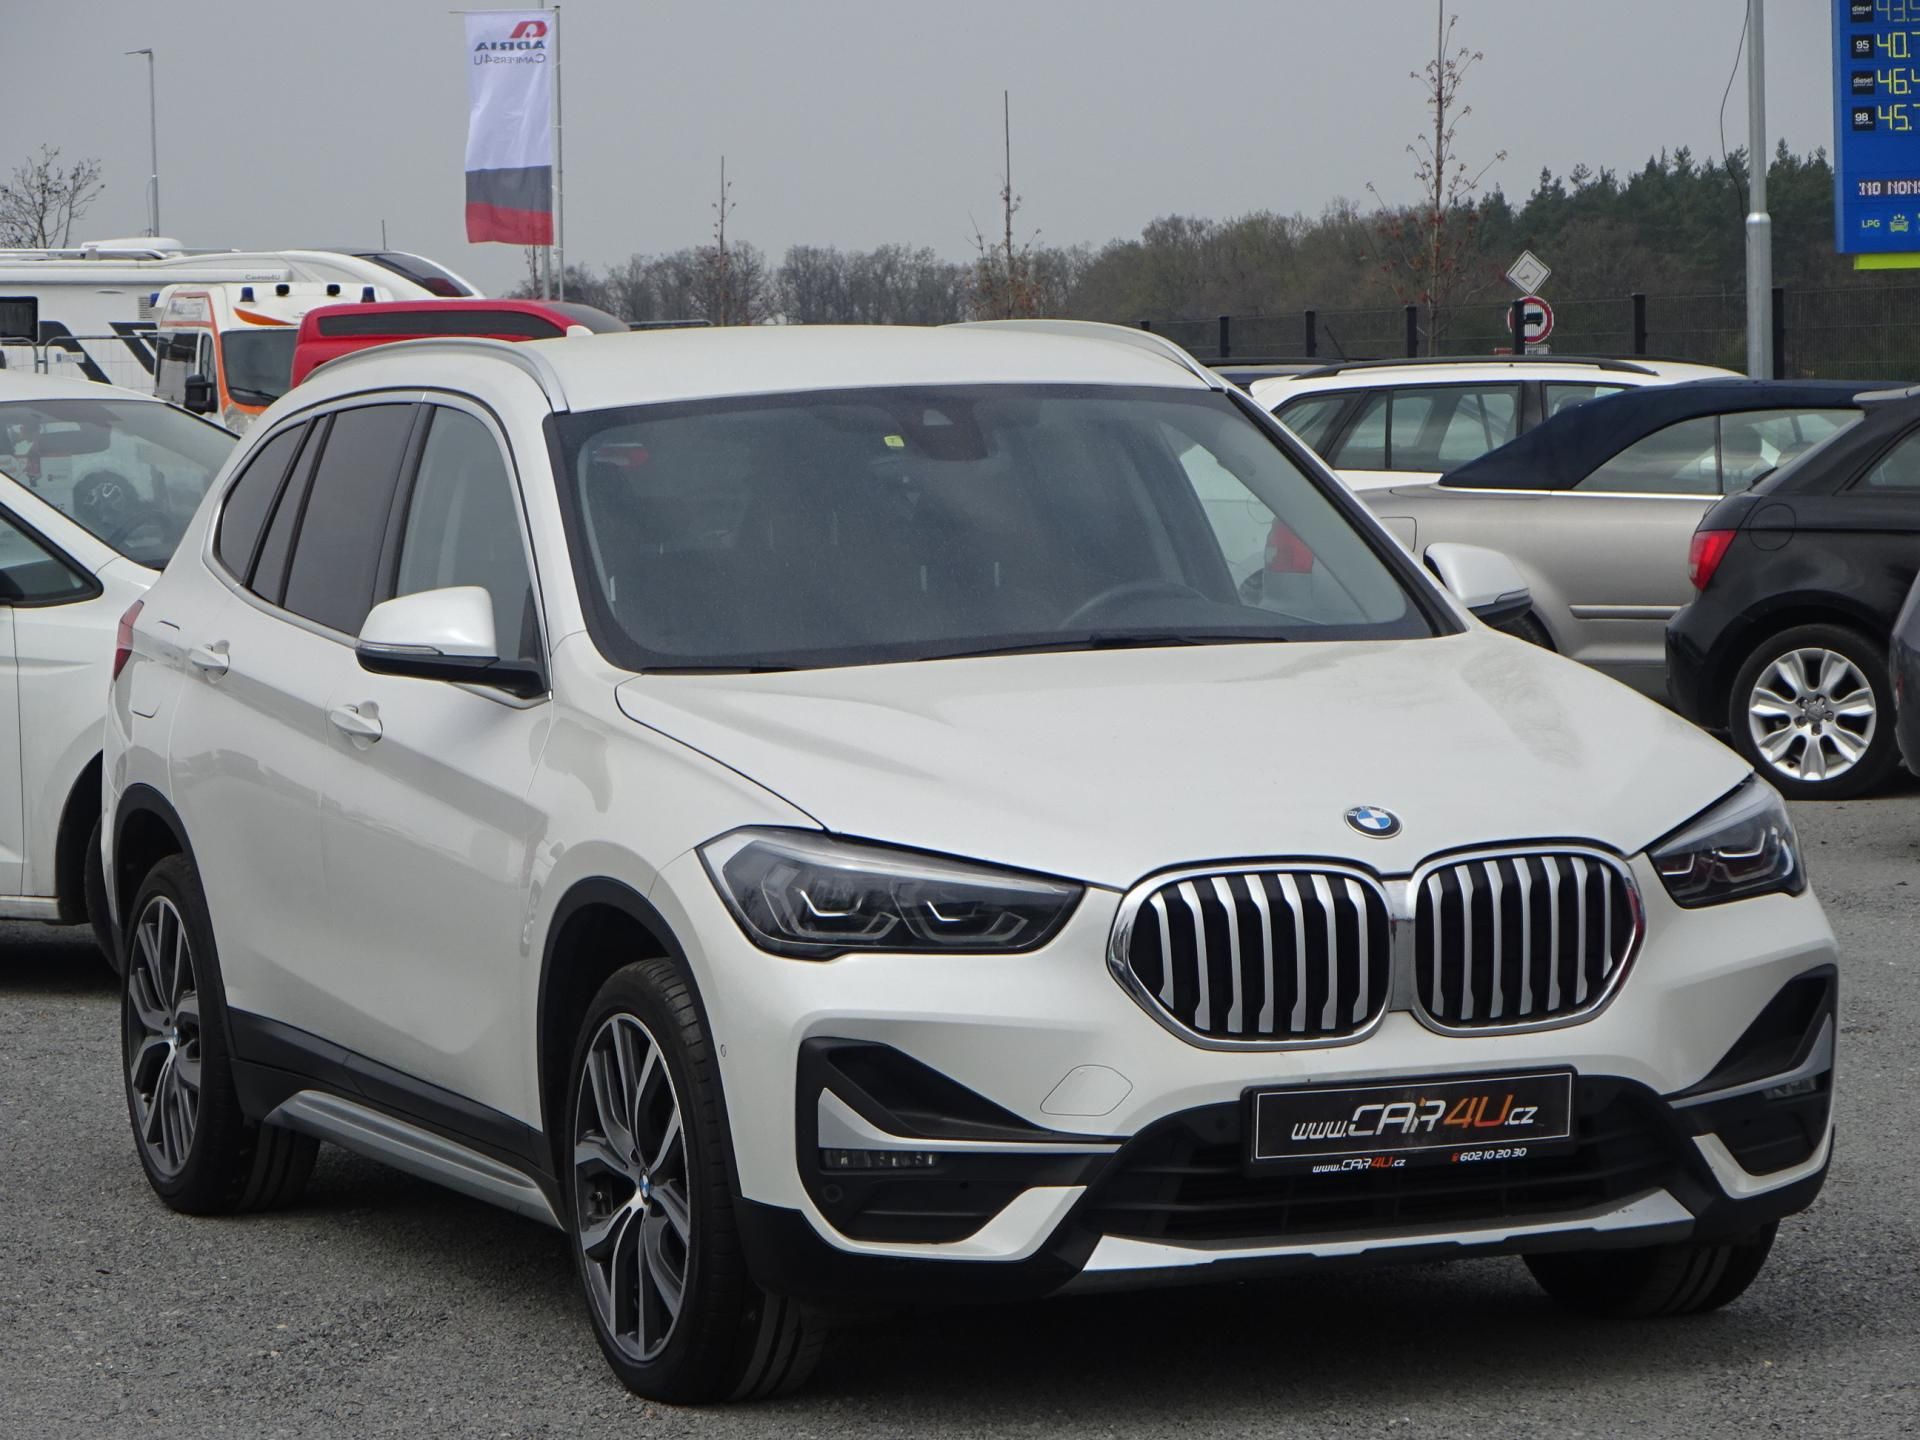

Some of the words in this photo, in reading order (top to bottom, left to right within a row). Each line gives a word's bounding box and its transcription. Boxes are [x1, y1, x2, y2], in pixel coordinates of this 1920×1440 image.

[1856, 40, 1870, 49] 95
[1855, 112, 1869, 121] 98
[1887, 180, 1920, 195] NON
[1862, 219, 1880, 229] LPG
[1291, 1094, 1538, 1141] www.CAR4U.cz
[1312, 1156, 1407, 1173] www.CAR4U.cz
[1460, 1151, 1482, 1162] 602
[1483, 1150, 1495, 1160] 10
[1495, 1148, 1511, 1159] 20
[1511, 1147, 1528, 1158] 30
